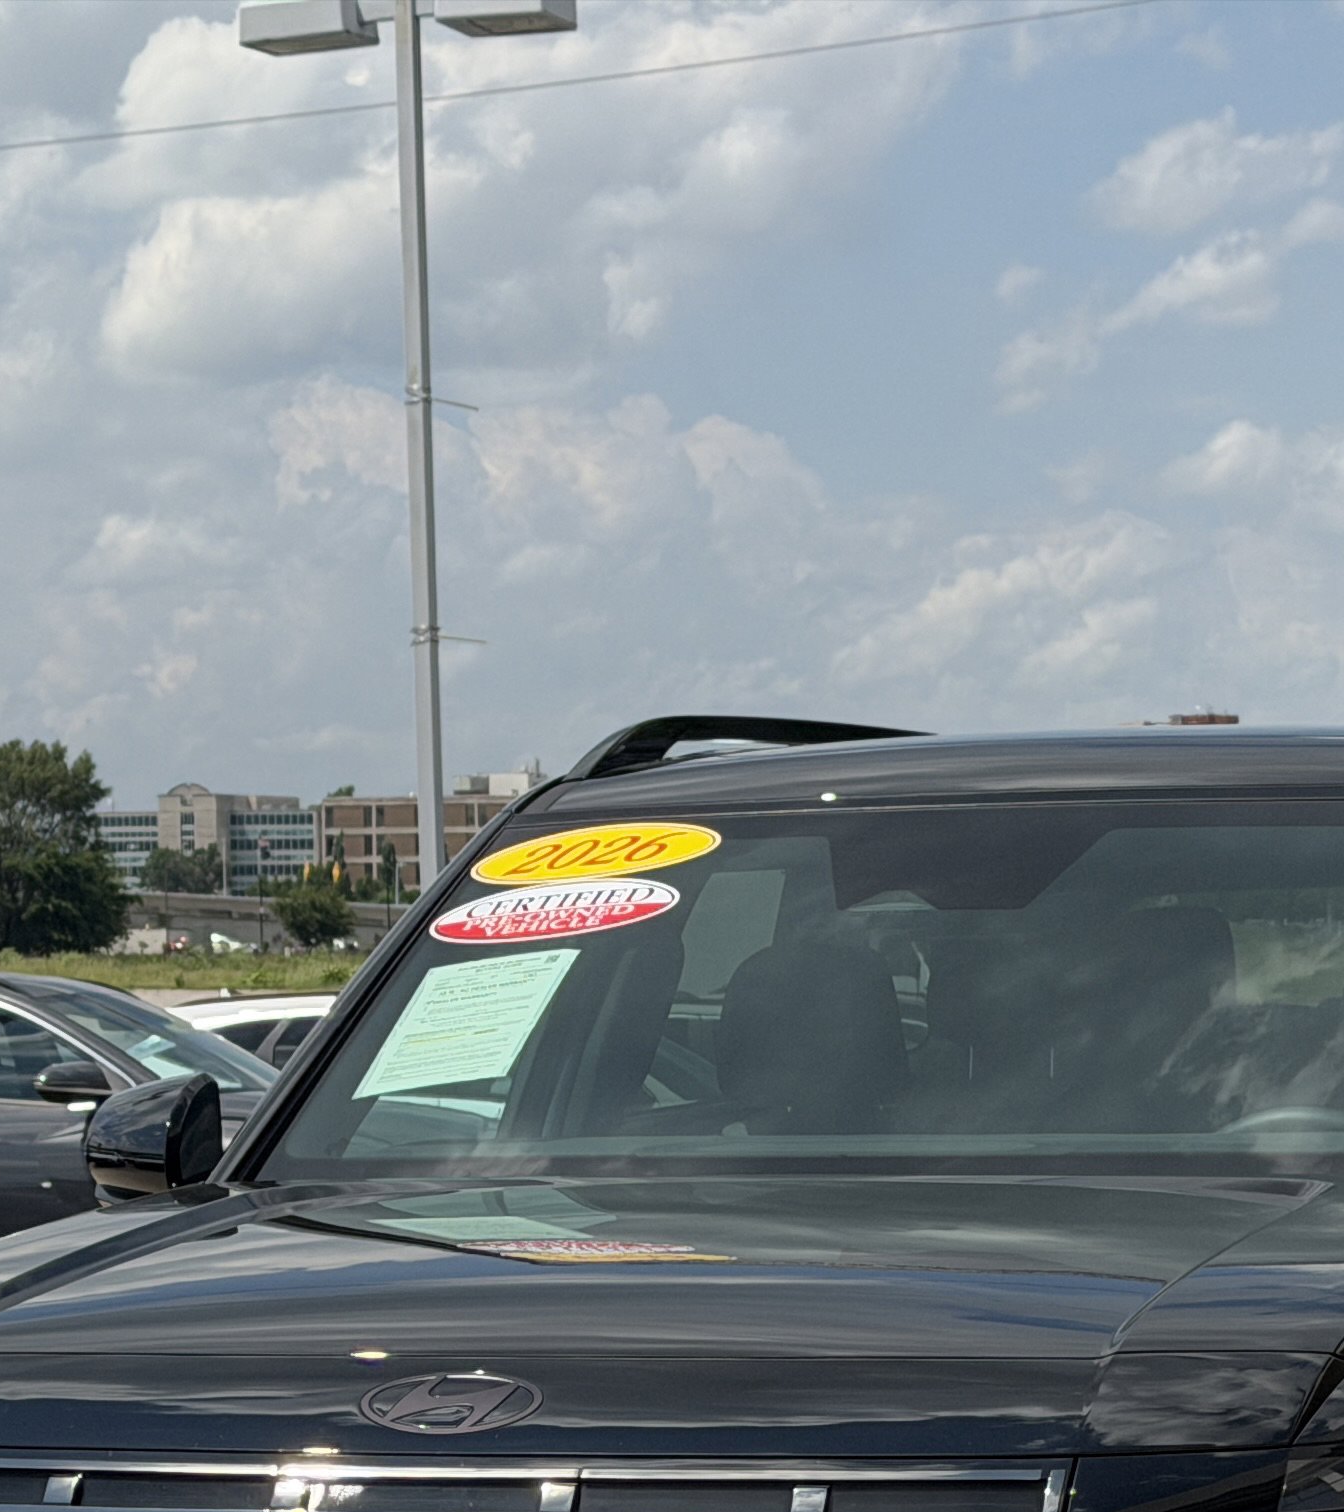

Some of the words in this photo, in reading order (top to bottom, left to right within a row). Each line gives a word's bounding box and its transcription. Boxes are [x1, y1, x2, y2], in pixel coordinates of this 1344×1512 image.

[502, 832, 688, 877] 2026
[467, 887, 655, 918] CERTIFIED
[463, 904, 635, 931] PRE-OWNED
[484, 916, 601, 937] VEHICLE
